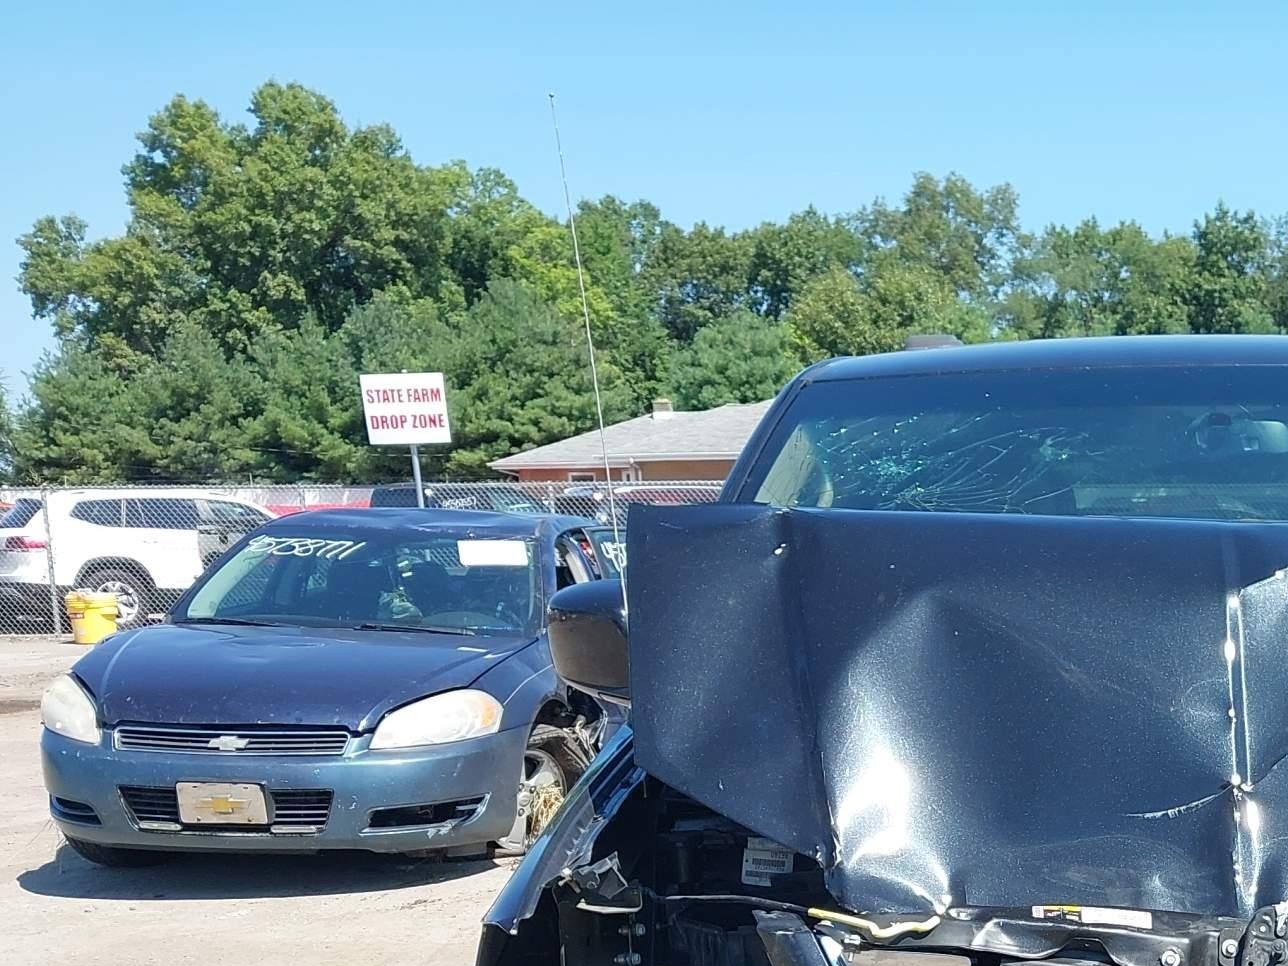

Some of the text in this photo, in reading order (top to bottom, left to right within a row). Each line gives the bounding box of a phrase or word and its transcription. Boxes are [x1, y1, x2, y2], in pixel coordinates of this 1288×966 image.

[366, 387, 442, 404] STATE FARM
[370, 413, 446, 430] DROP ZONE
